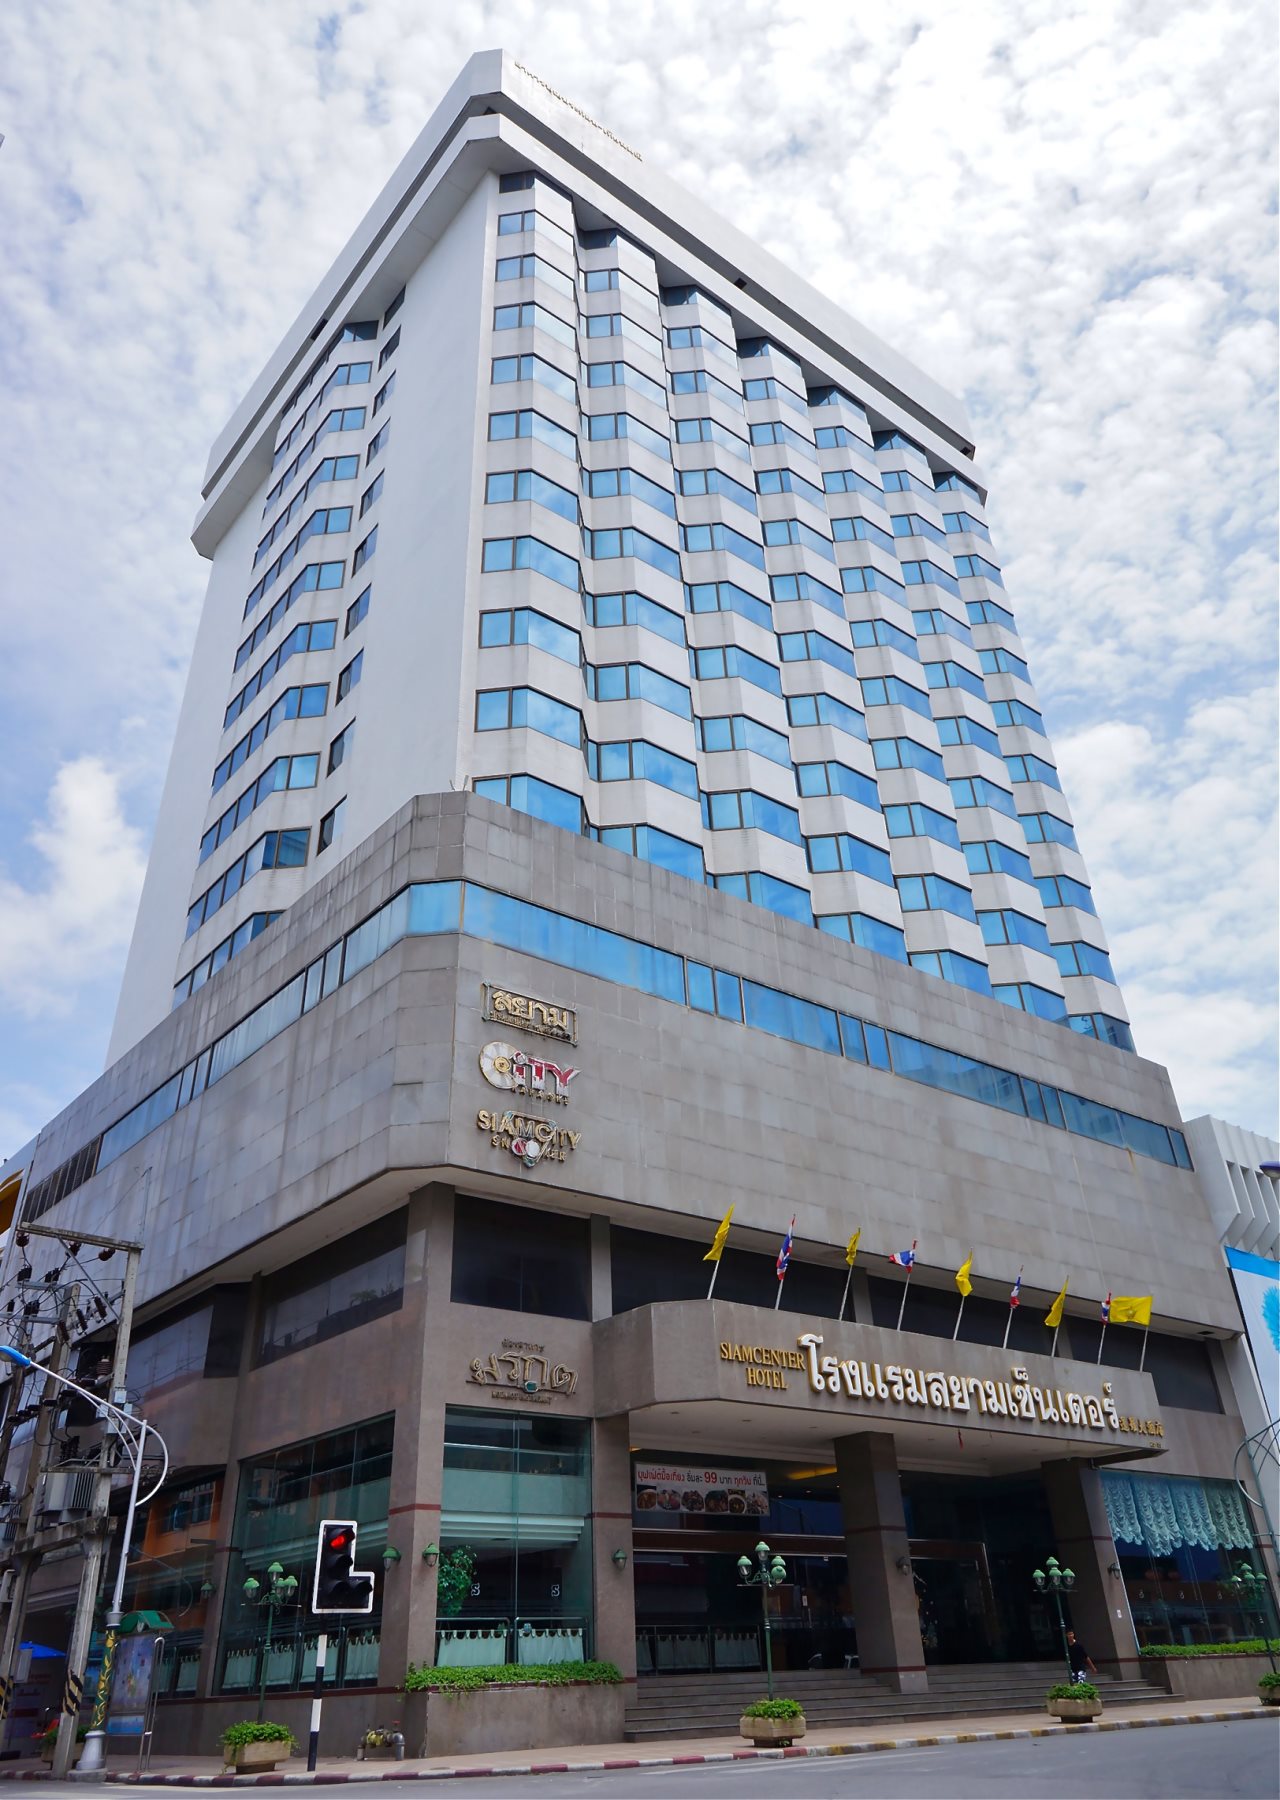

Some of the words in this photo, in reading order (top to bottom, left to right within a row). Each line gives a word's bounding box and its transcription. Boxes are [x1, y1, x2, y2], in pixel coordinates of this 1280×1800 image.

[492, 990, 569, 1031] สยาม
[720, 1342, 806, 1371] SIAMCENTER
[747, 1367, 788, 1390] HOTEL
[797, 1333, 1120, 1429] โรงแรมสยามเซ็นเตอร์
[704, 1471, 718, 1484] 99
[719, 1476, 732, 1485] บาท
[734, 1474, 752, 1487] ทุกวัน
